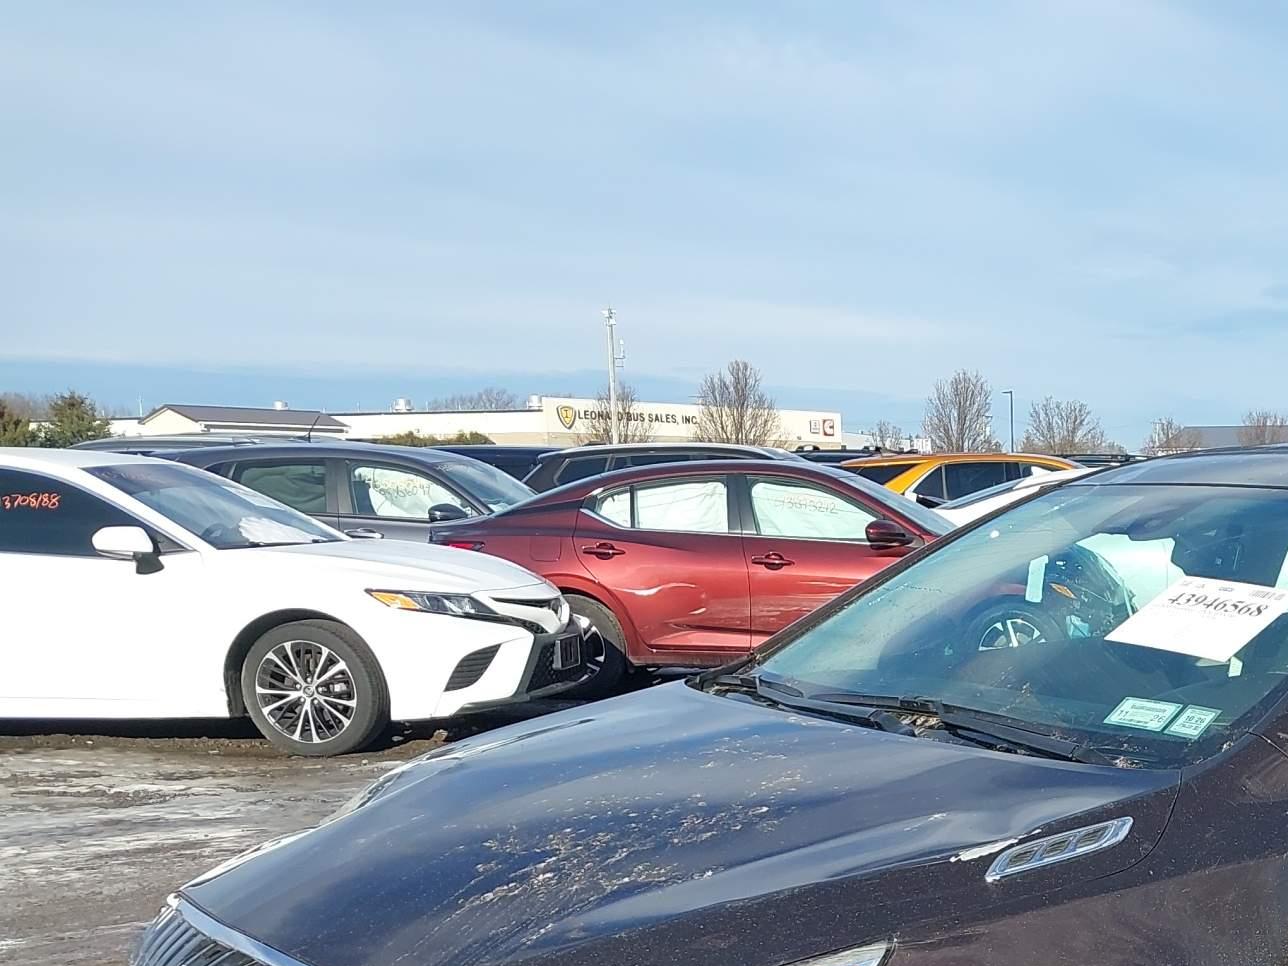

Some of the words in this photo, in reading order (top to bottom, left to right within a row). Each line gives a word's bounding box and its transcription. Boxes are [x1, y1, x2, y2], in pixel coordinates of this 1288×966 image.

[578, 410, 624, 422] LEONAD
[626, 411, 645, 422] BUS
[648, 413, 679, 425] SALES,
[1168, 592, 1269, 617] 43946568
